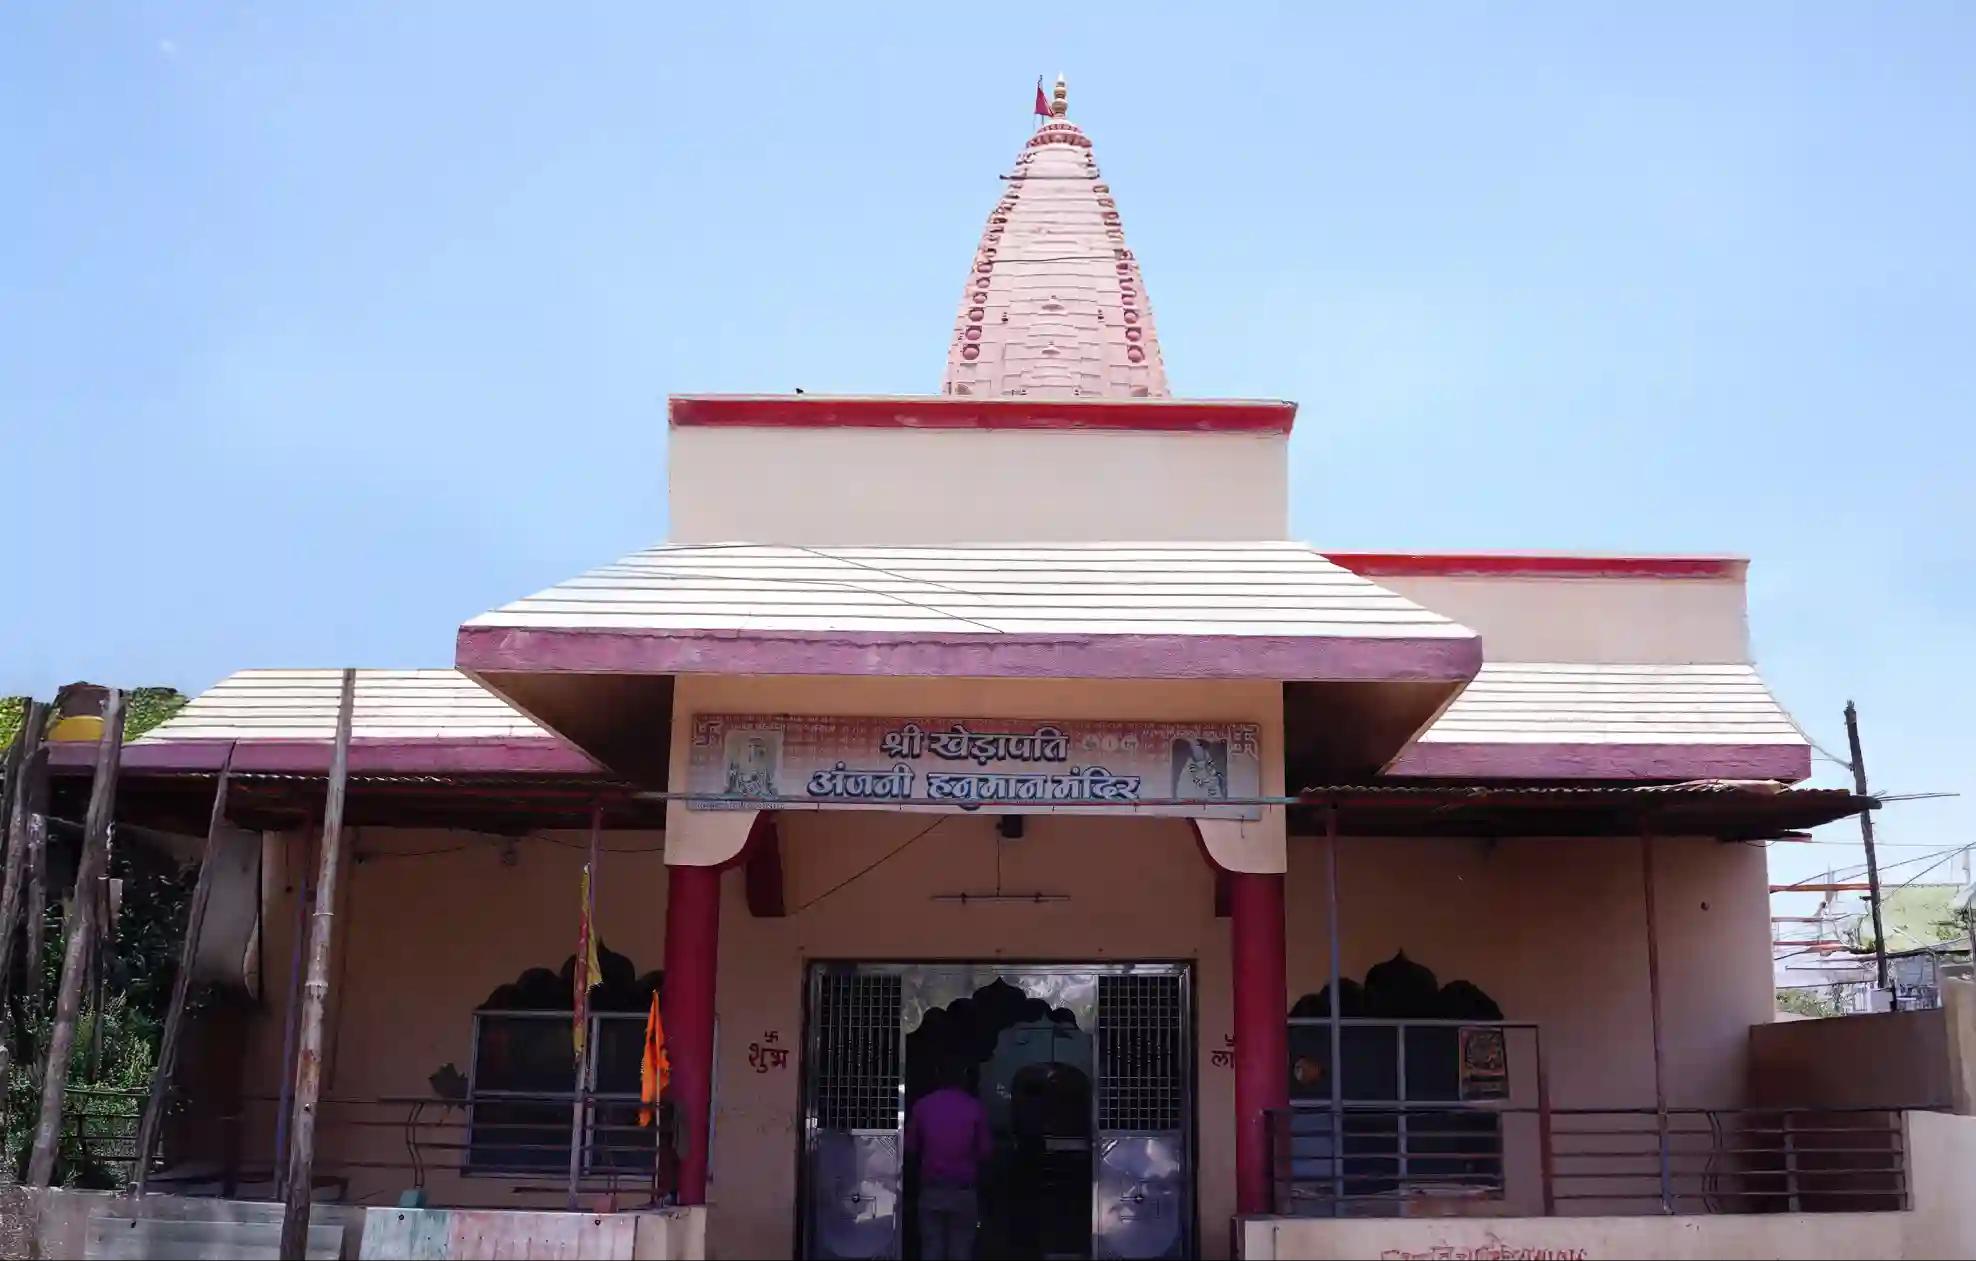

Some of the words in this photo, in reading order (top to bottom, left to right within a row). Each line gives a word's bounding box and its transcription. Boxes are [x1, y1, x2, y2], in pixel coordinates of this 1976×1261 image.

[879, 723, 924, 759] श्री
[927, 724, 1069, 765] खेड़ापति
[806, 761, 915, 797] अंजनी
[926, 772, 1047, 811] हनुमान
[1049, 766, 1141, 801] मंदिर
[748, 1042, 789, 1074] शुभ
[1211, 1050, 1236, 1069] ला
